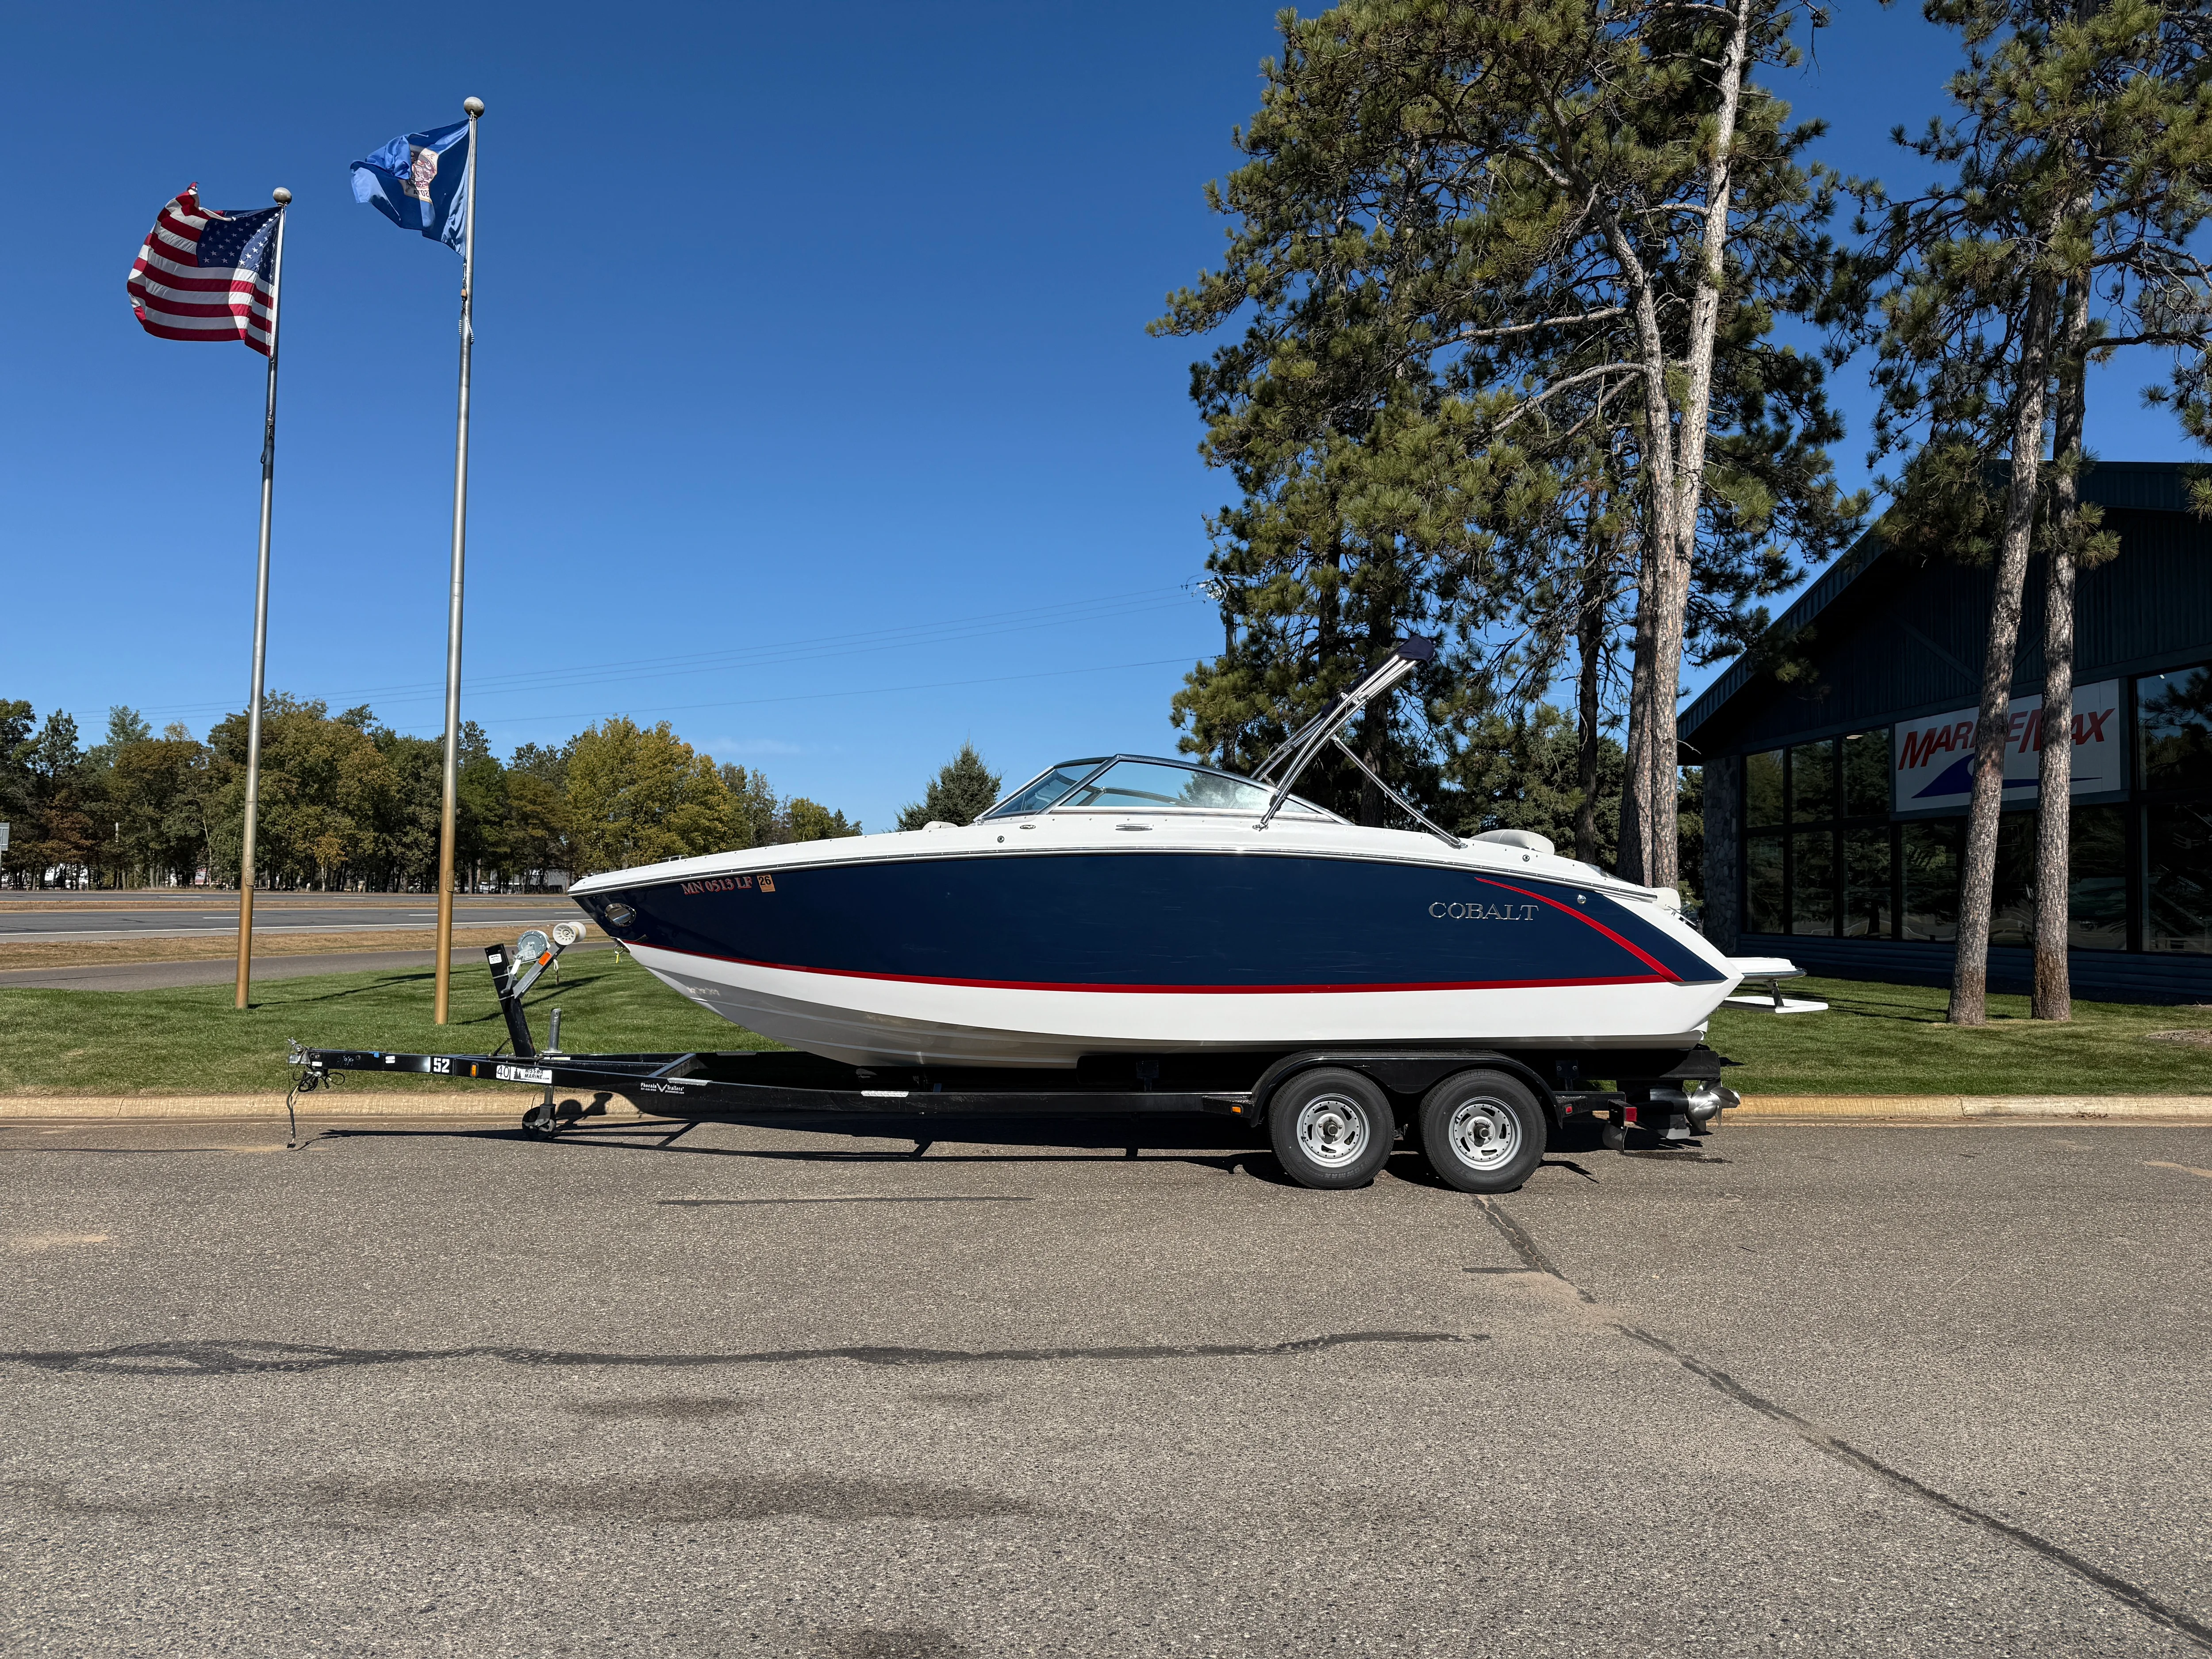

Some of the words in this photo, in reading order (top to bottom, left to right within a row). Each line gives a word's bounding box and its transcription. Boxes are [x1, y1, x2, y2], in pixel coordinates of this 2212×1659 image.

[680, 881, 705, 895] MN
[705, 878, 734, 892] 0513
[758, 876, 771, 885] 26
[1429, 902, 1539, 920] COBALT
[434, 1058, 449, 1073] 52
[497, 1066, 509, 1078] 40
